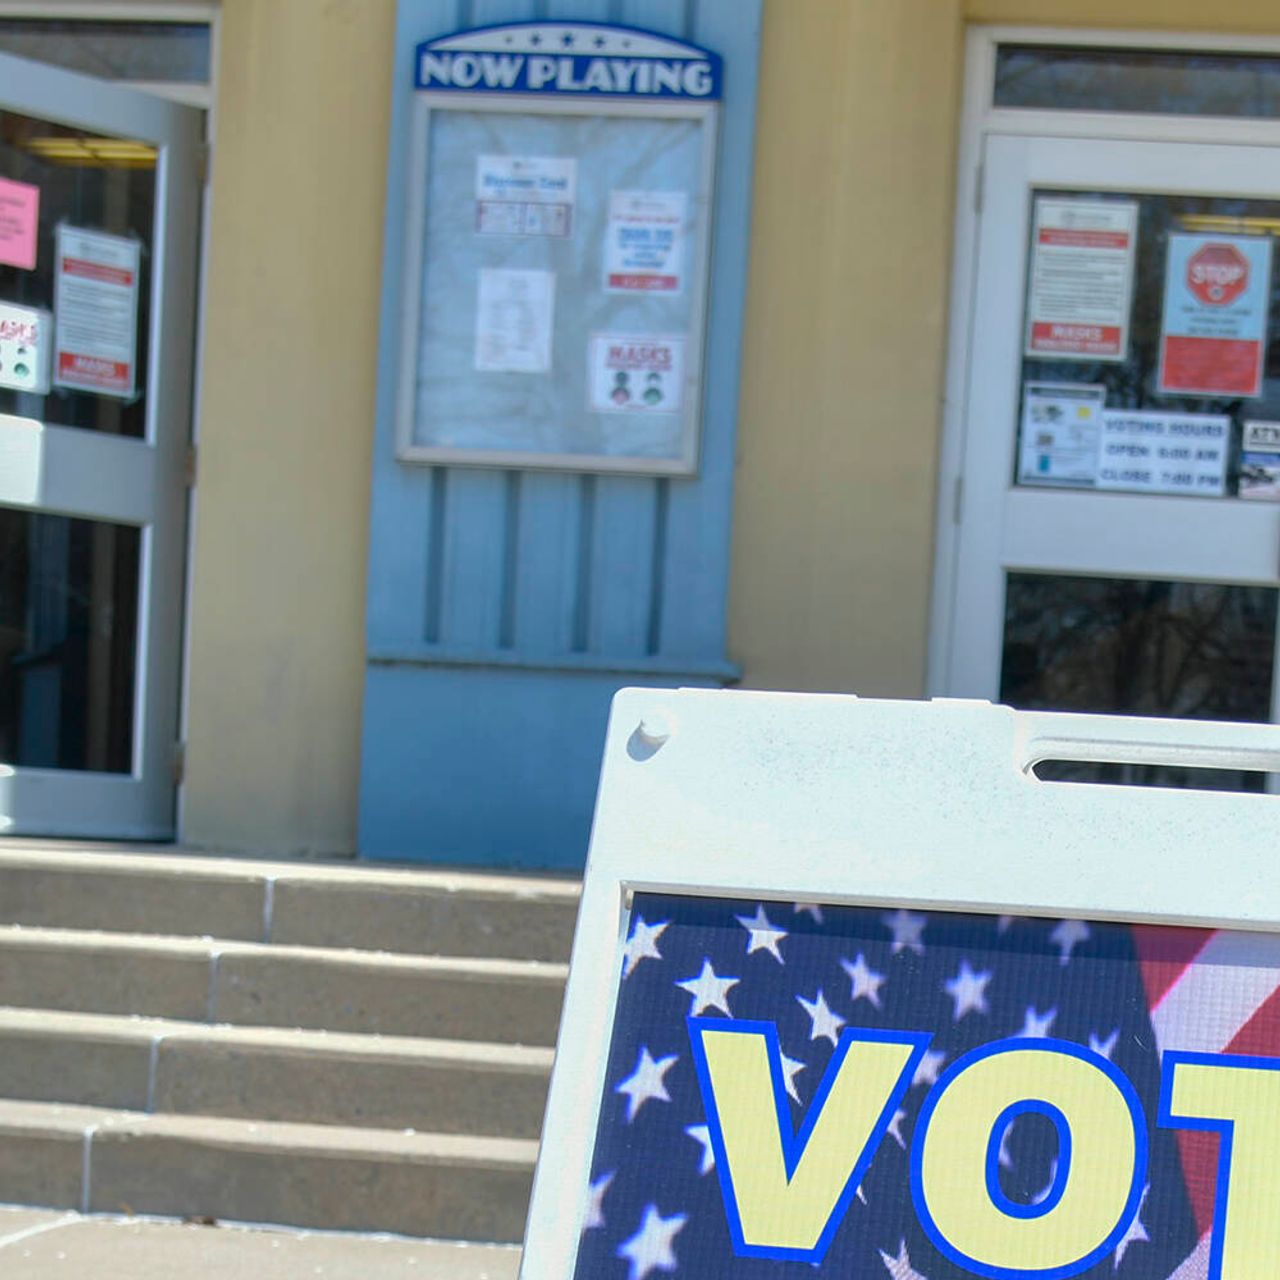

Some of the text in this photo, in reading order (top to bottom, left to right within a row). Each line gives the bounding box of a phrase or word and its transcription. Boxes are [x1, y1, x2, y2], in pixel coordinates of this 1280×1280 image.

[420, 52, 713, 97] NOW PLAYING
[1190, 263, 1245, 286] STOP
[607, 345, 672, 364] MASKS
[1105, 418, 1225, 438] VOTING HOURS
[1101, 468, 1152, 484] CLOSE
